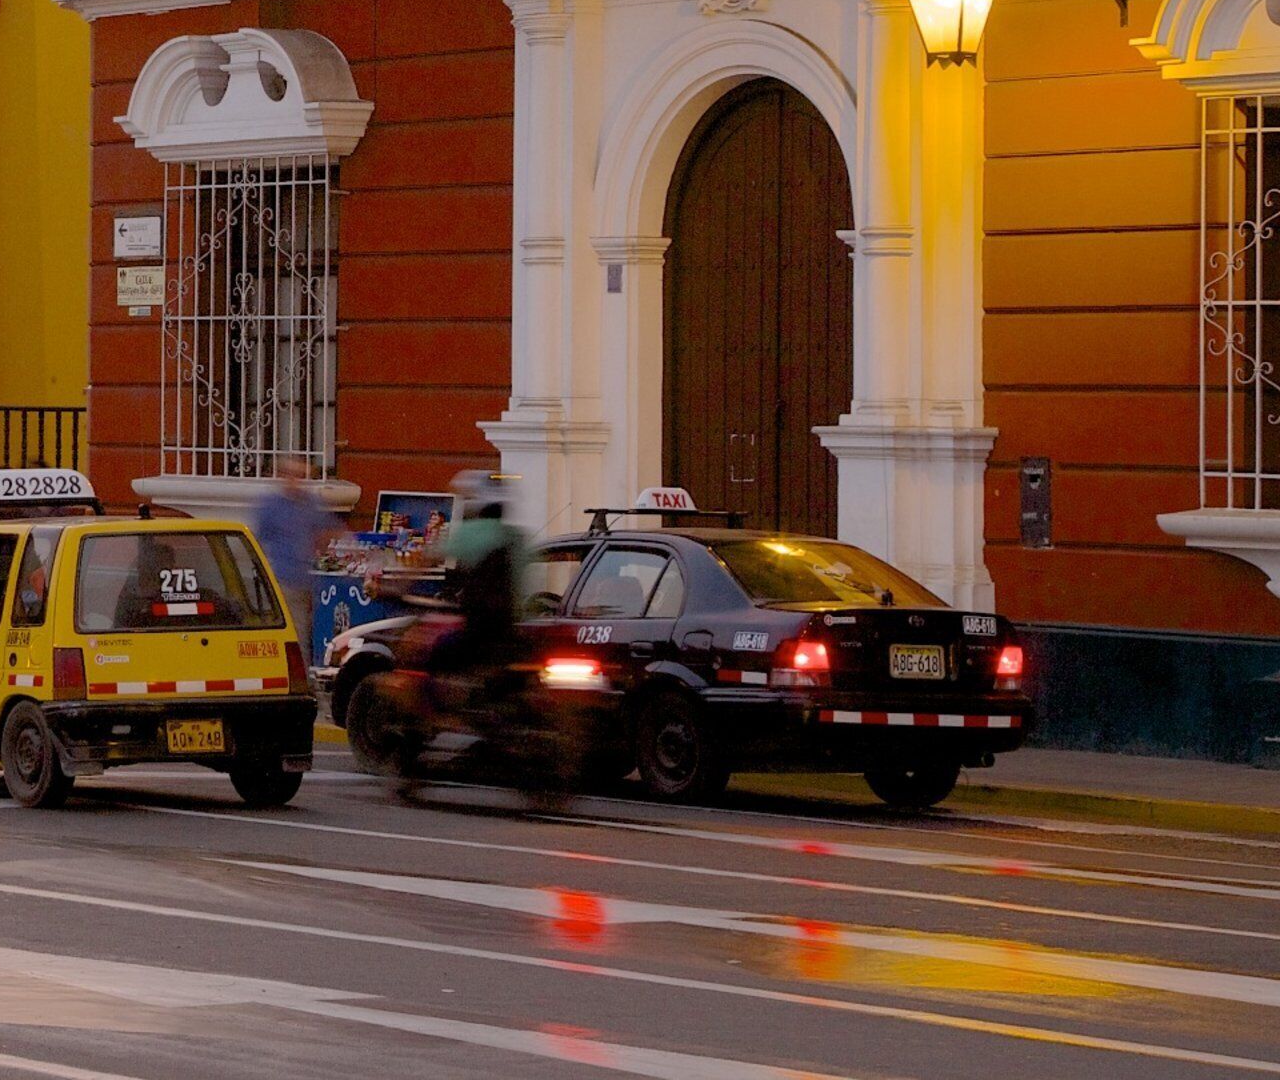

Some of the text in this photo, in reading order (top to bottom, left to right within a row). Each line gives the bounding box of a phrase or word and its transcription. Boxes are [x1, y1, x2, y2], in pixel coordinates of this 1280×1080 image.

[2, 475, 82, 497] 282828
[652, 493, 687, 508] TAXI
[160, 568, 198, 592] 275
[576, 626, 612, 644] 0238
[966, 617, 996, 634] A8G-618
[892, 653, 939, 673] A8G-618
